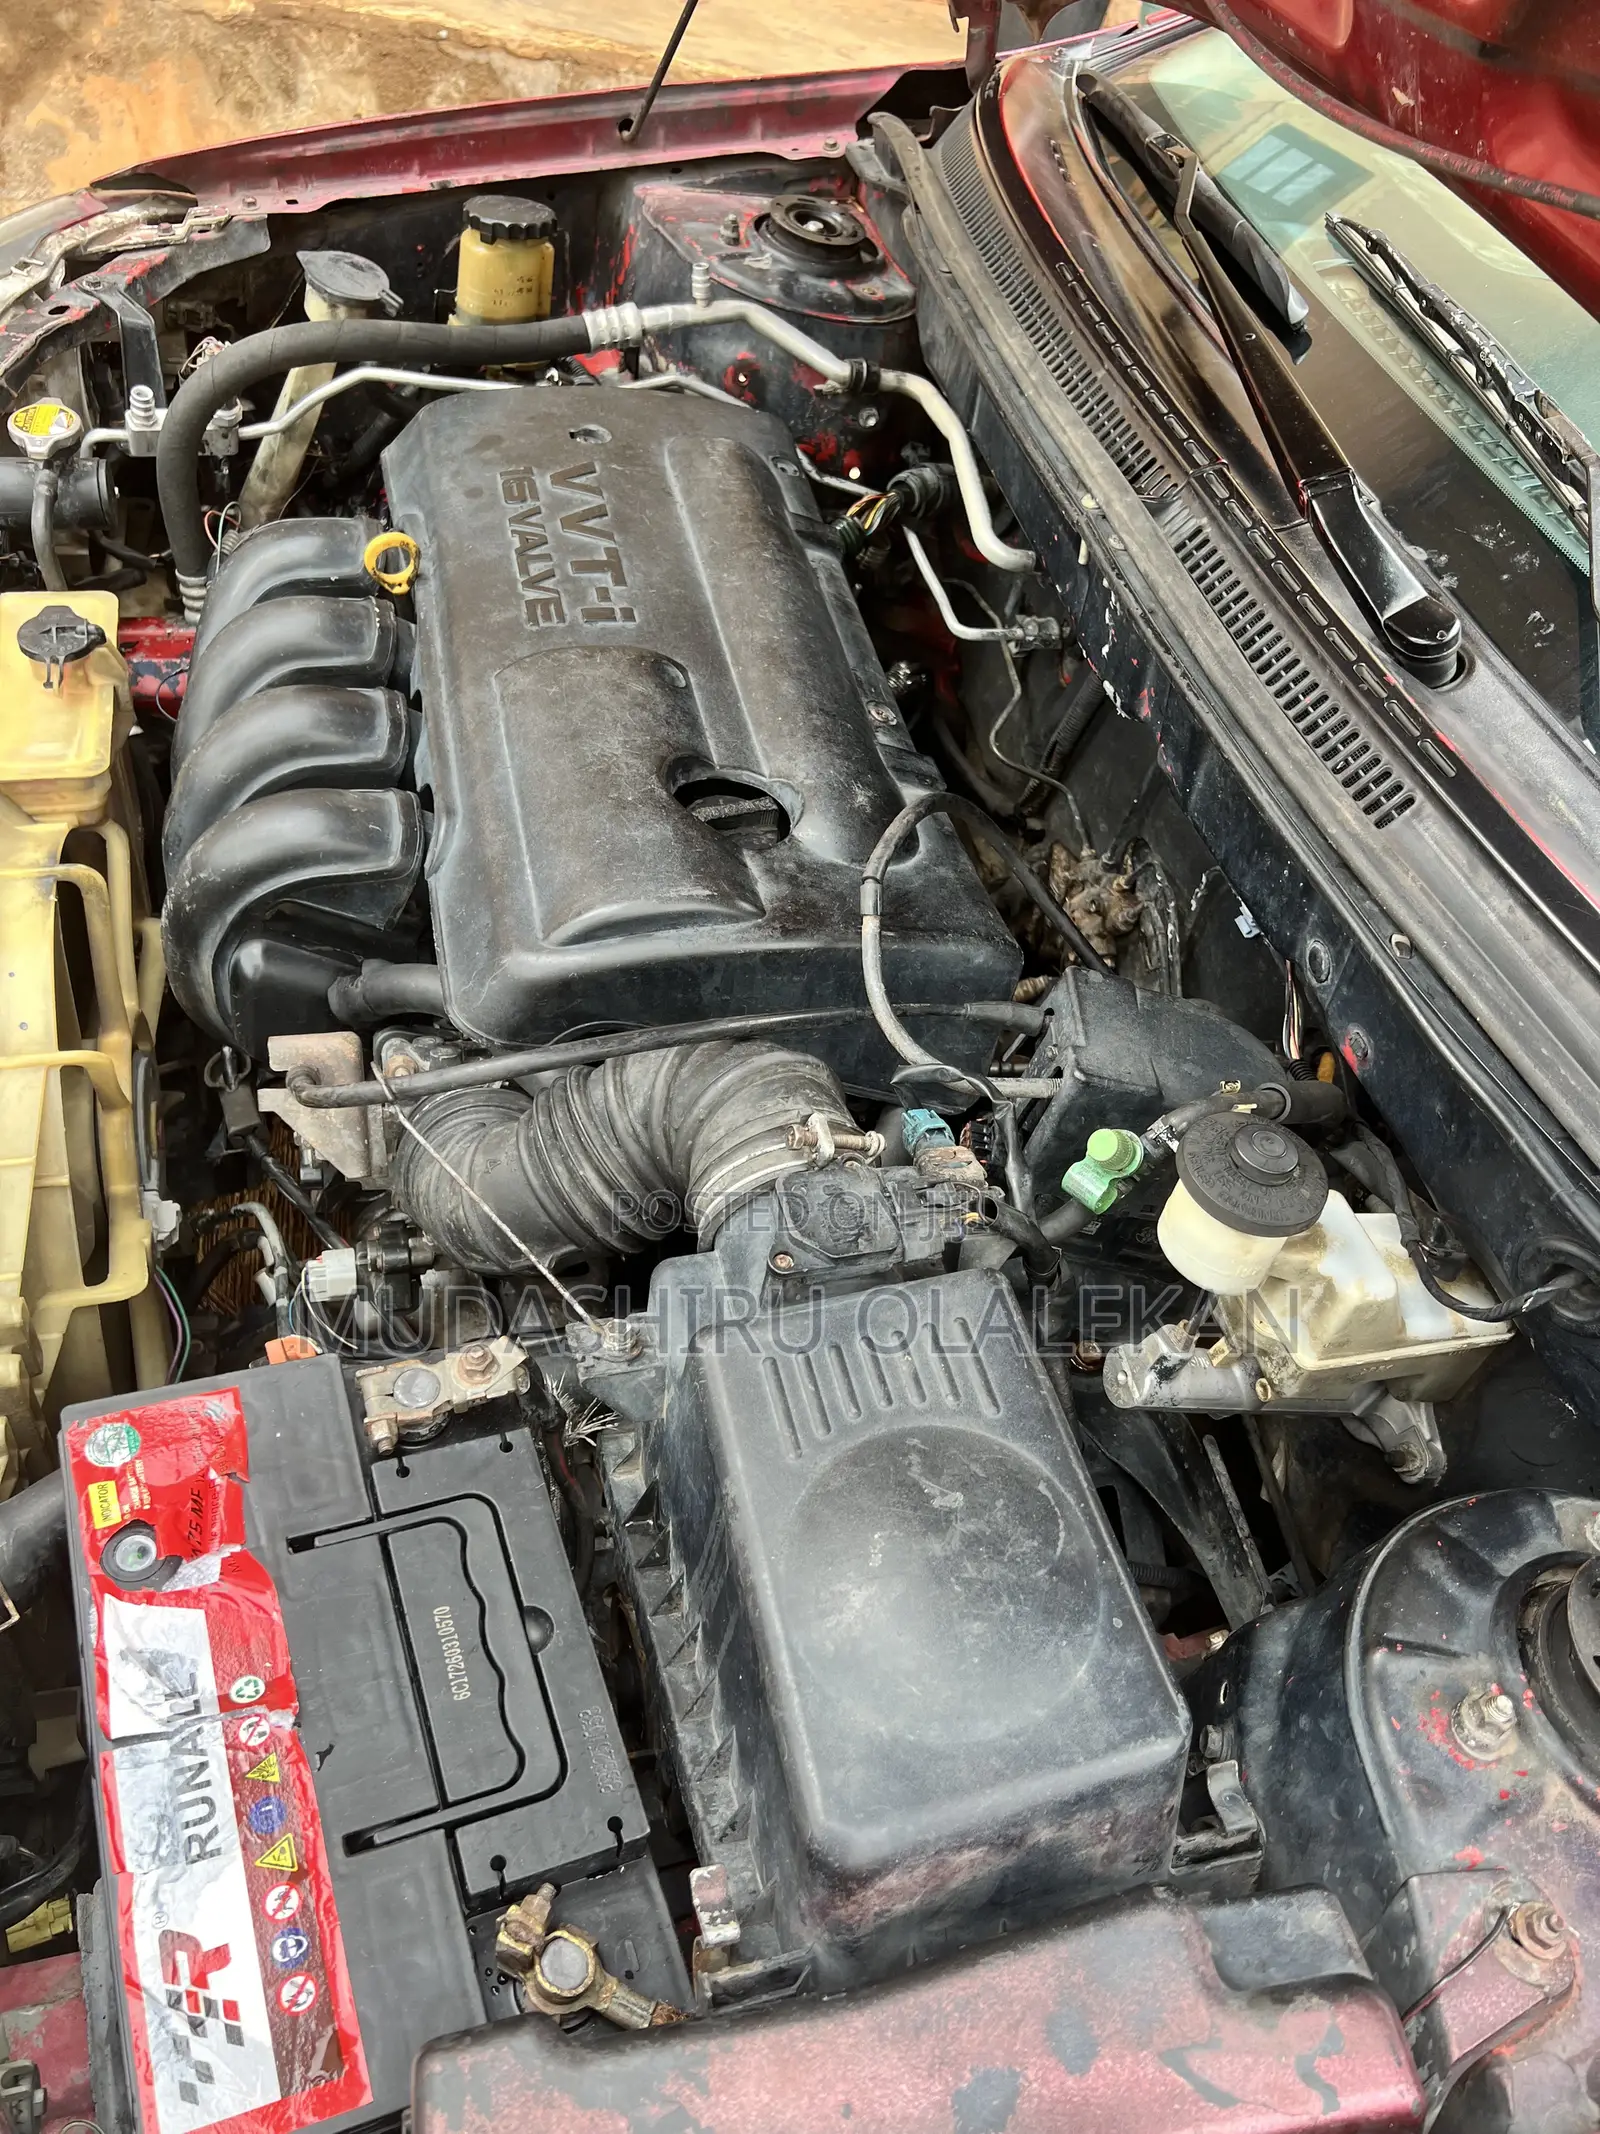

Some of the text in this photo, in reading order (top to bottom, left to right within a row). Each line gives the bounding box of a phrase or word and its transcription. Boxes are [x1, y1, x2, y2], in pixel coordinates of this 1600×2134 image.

[549, 461, 637, 624] VVT-i
[97, 1483, 112, 1523] INDICATOR
[433, 1605, 471, 1701] 6C17260310570
[164, 1671, 222, 1866] RUNALL
